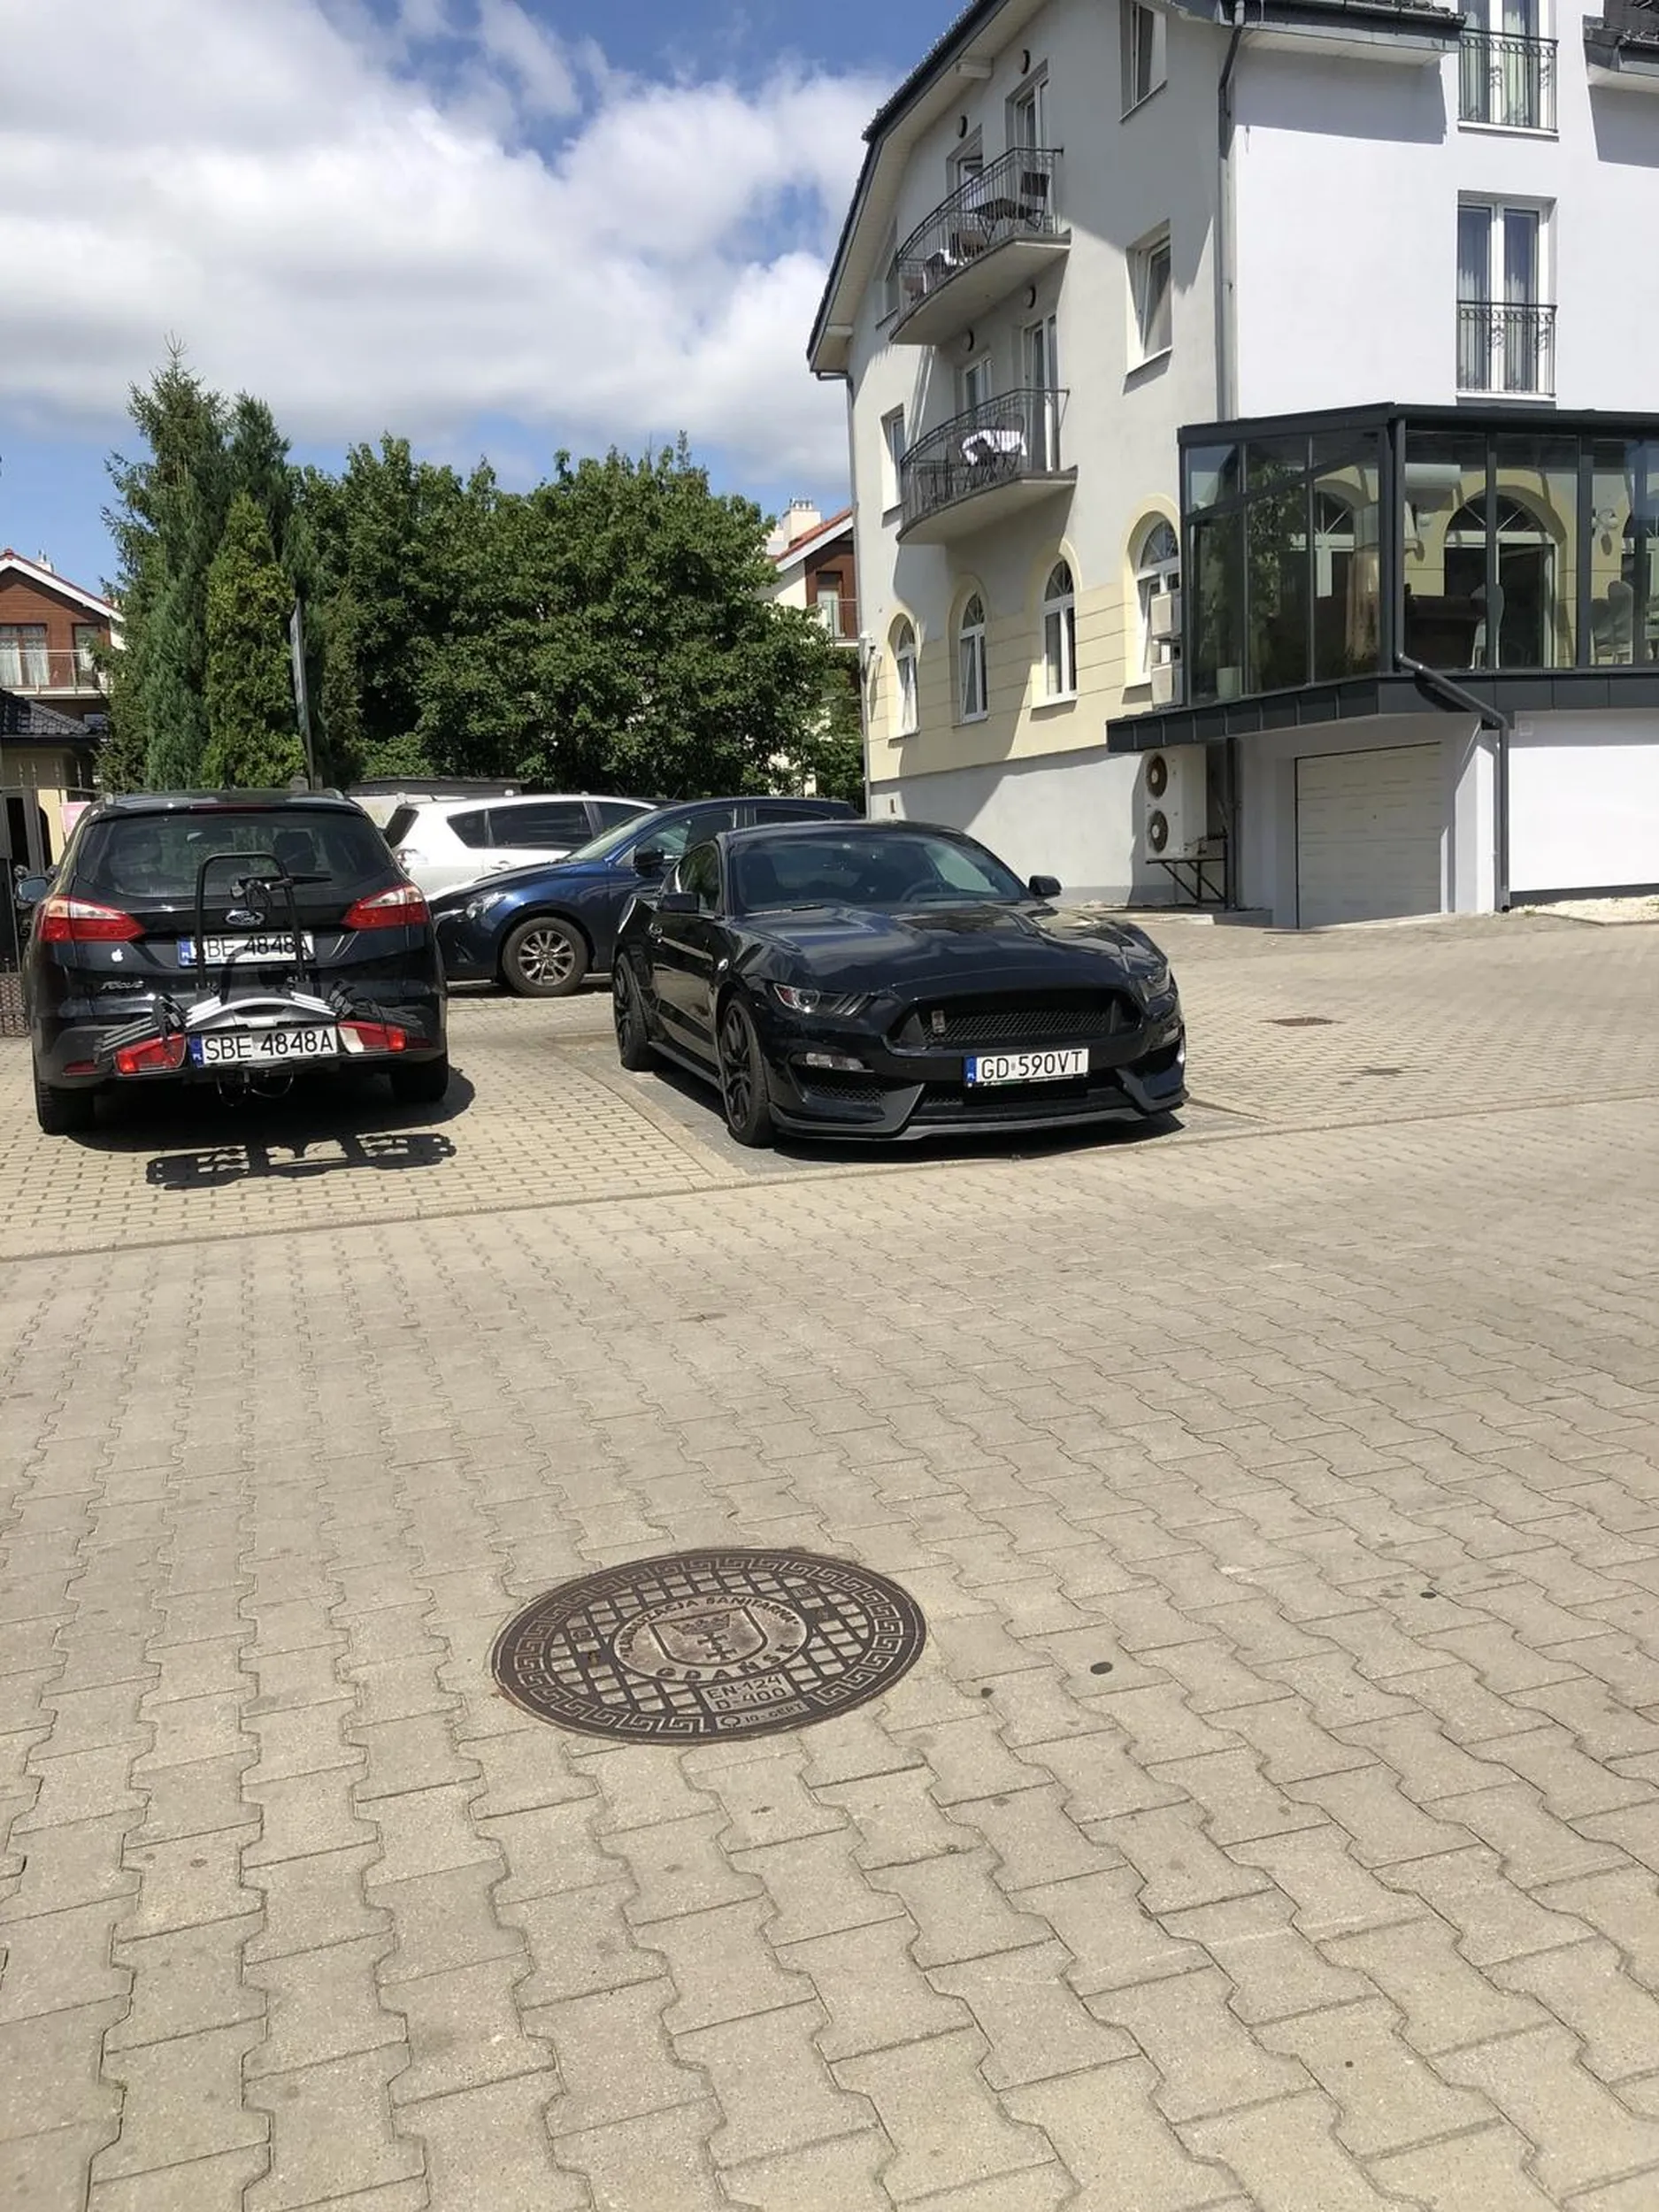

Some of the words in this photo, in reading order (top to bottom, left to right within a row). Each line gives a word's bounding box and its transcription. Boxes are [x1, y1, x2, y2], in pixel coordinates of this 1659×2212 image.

[194, 936, 235, 958] BE
[204, 1034, 252, 1061] SBE
[261, 1030, 334, 1056] 4848A
[981, 1057, 1009, 1079] GD
[1018, 1051, 1082, 1077] 590VT
